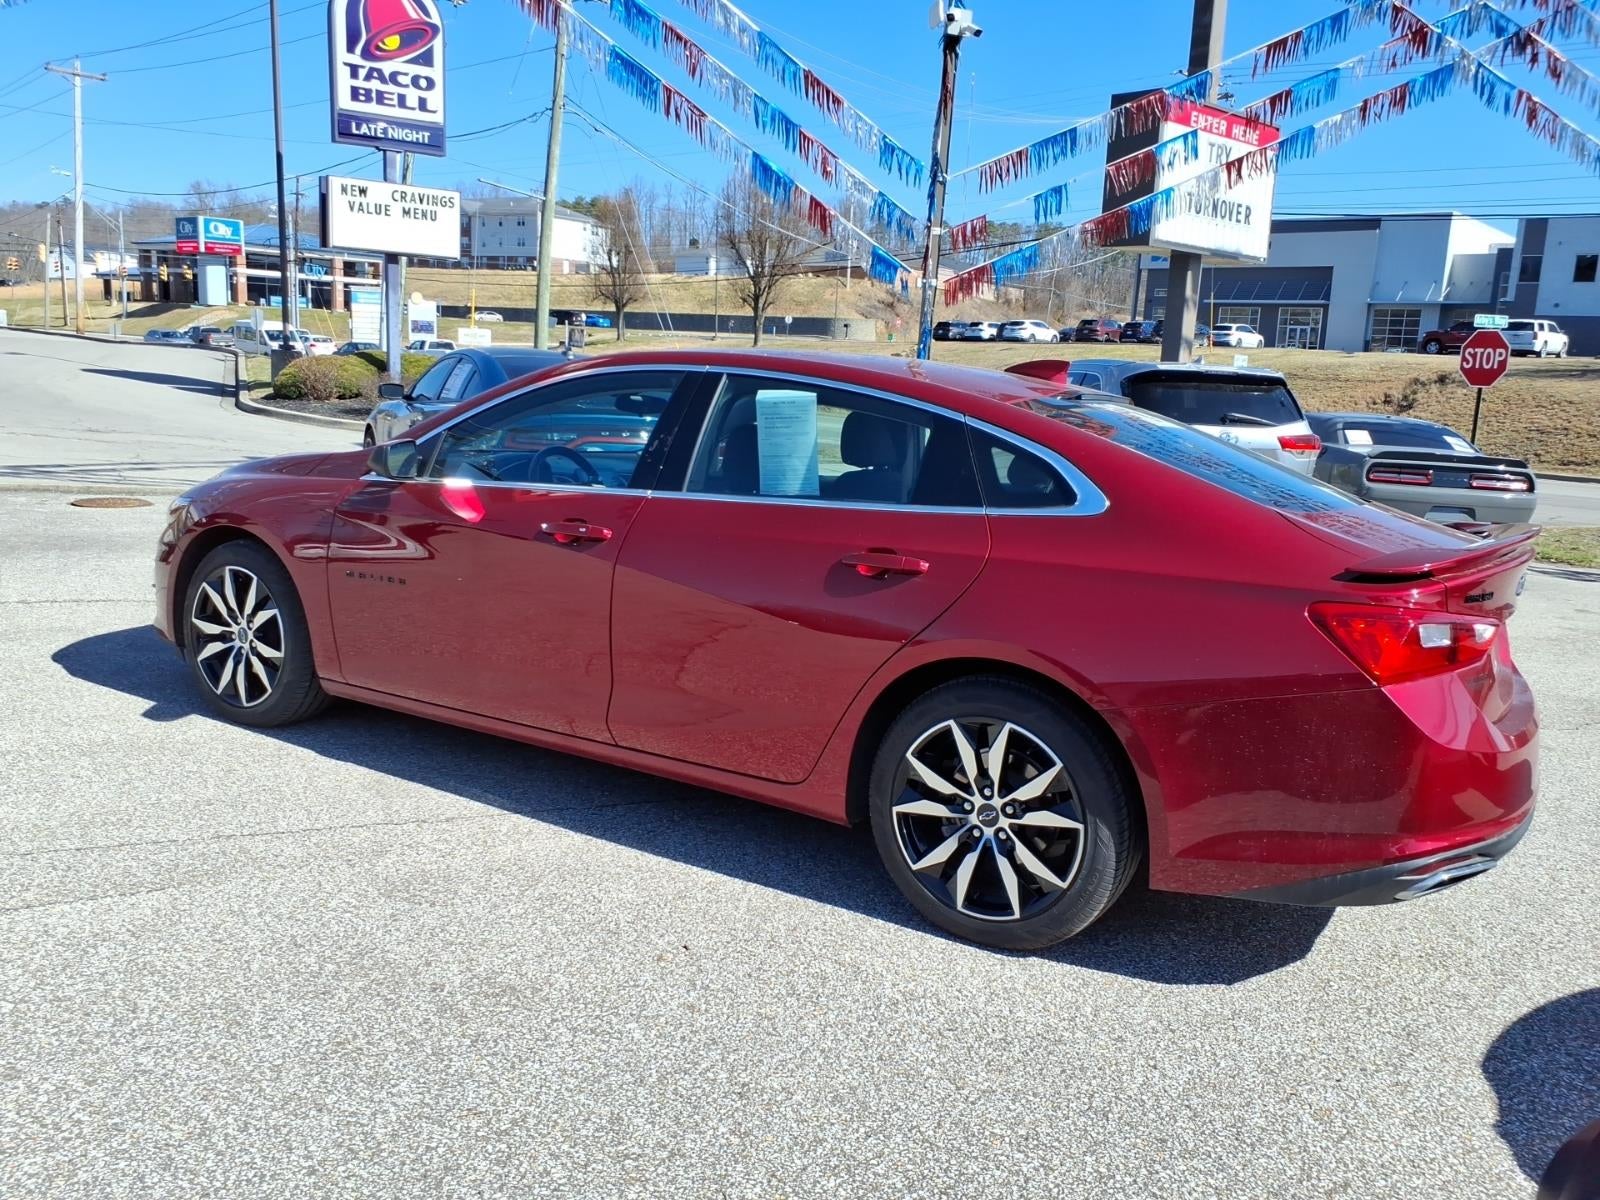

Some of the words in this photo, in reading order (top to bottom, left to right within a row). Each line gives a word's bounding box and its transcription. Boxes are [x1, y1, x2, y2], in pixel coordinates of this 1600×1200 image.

[343, 61, 436, 92] TACO
[350, 85, 438, 114] BELL
[351, 121, 385, 138] LATE
[387, 125, 431, 144] NIGHT
[1190, 111, 1228, 136] ENTER
[1208, 142, 1232, 165] TRY
[341, 183, 368, 198] NEW
[391, 190, 456, 209] CRAVINGS
[348, 200, 392, 217] VALUE
[402, 206, 438, 222] MENU
[1187, 192, 1252, 226] TURNOVER
[1462, 348, 1507, 369] STOP
